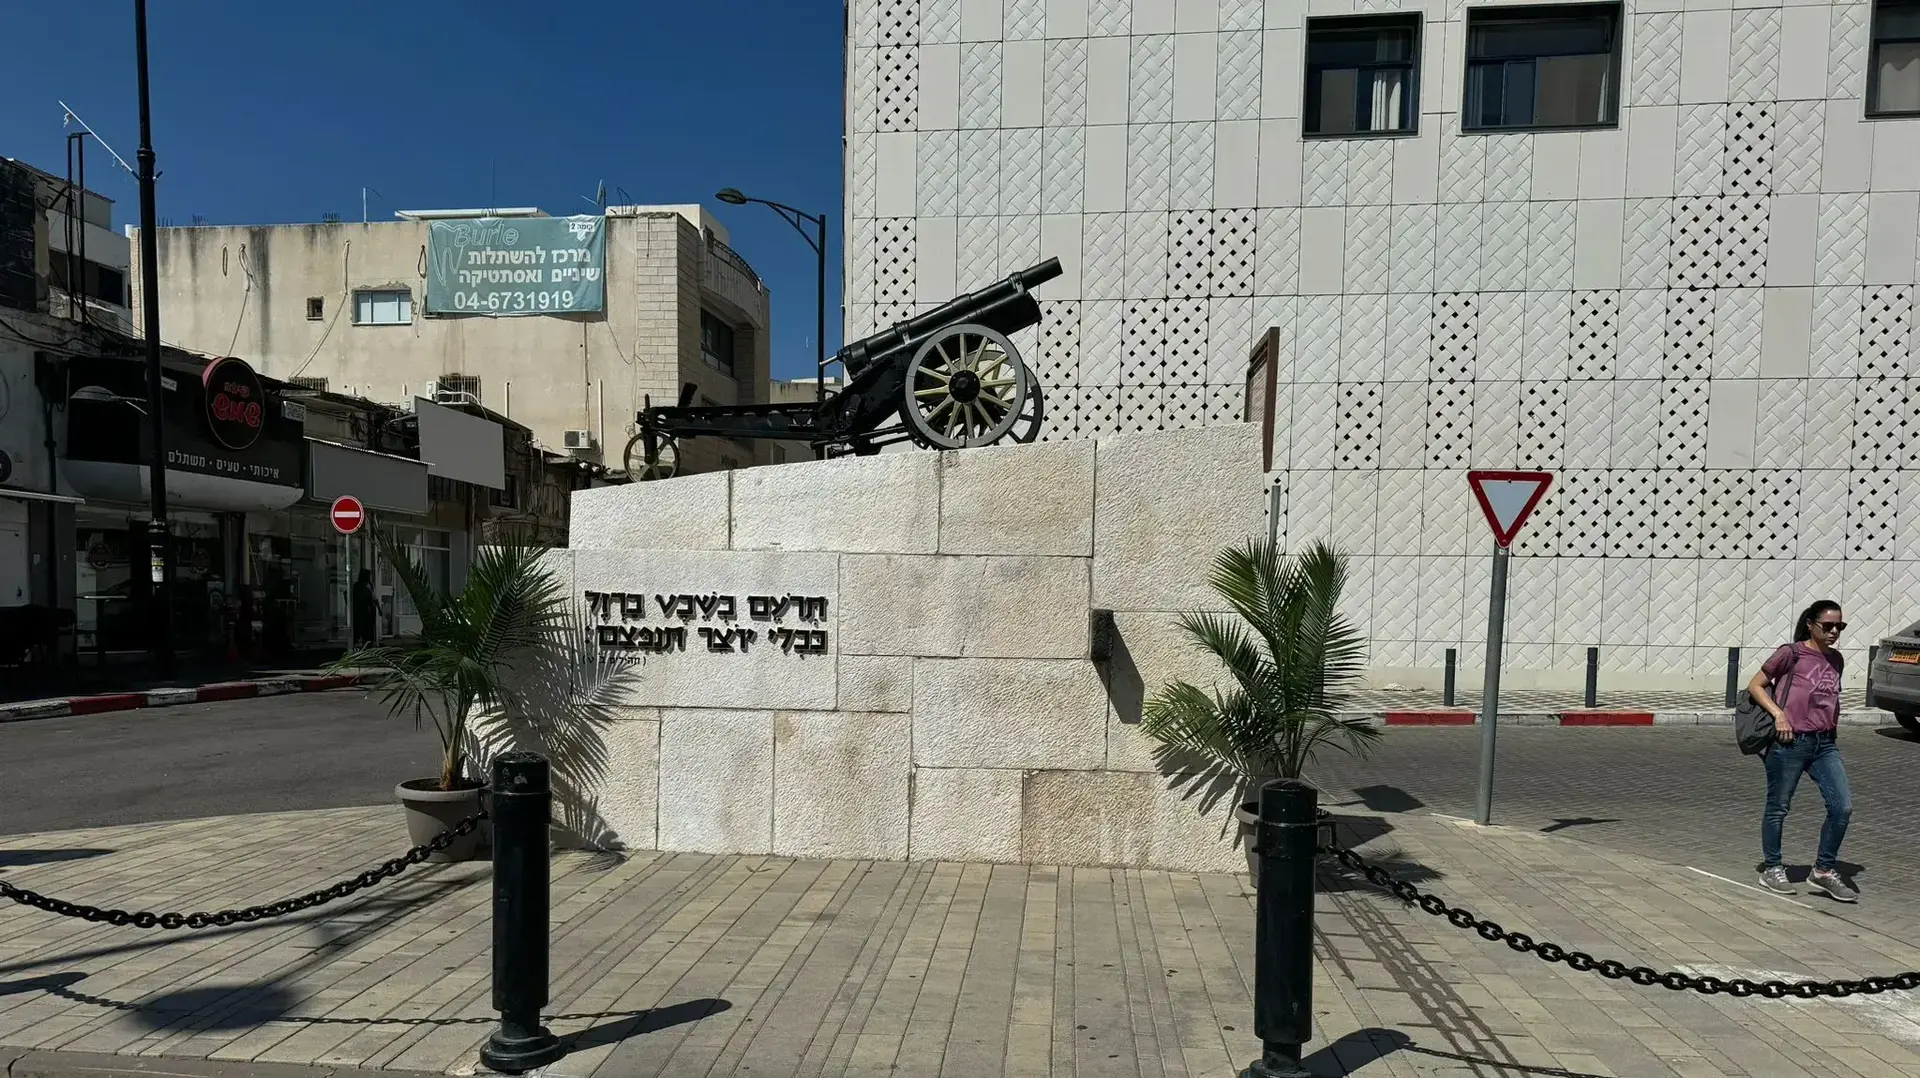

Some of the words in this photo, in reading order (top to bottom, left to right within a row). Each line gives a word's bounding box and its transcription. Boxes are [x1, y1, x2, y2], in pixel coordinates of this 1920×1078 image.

[577, 223, 593, 231] קומה
[468, 246, 546, 265] להשתלות
[551, 249, 591, 264] מרכז
[458, 268, 542, 288] ואסתטיקה
[551, 267, 600, 283] שיניים
[454, 290, 574, 310] 04-6731919
[168, 450, 206, 467] משתלם
[216, 458, 240, 473] טעים
[250, 464, 279, 478] איכותי
